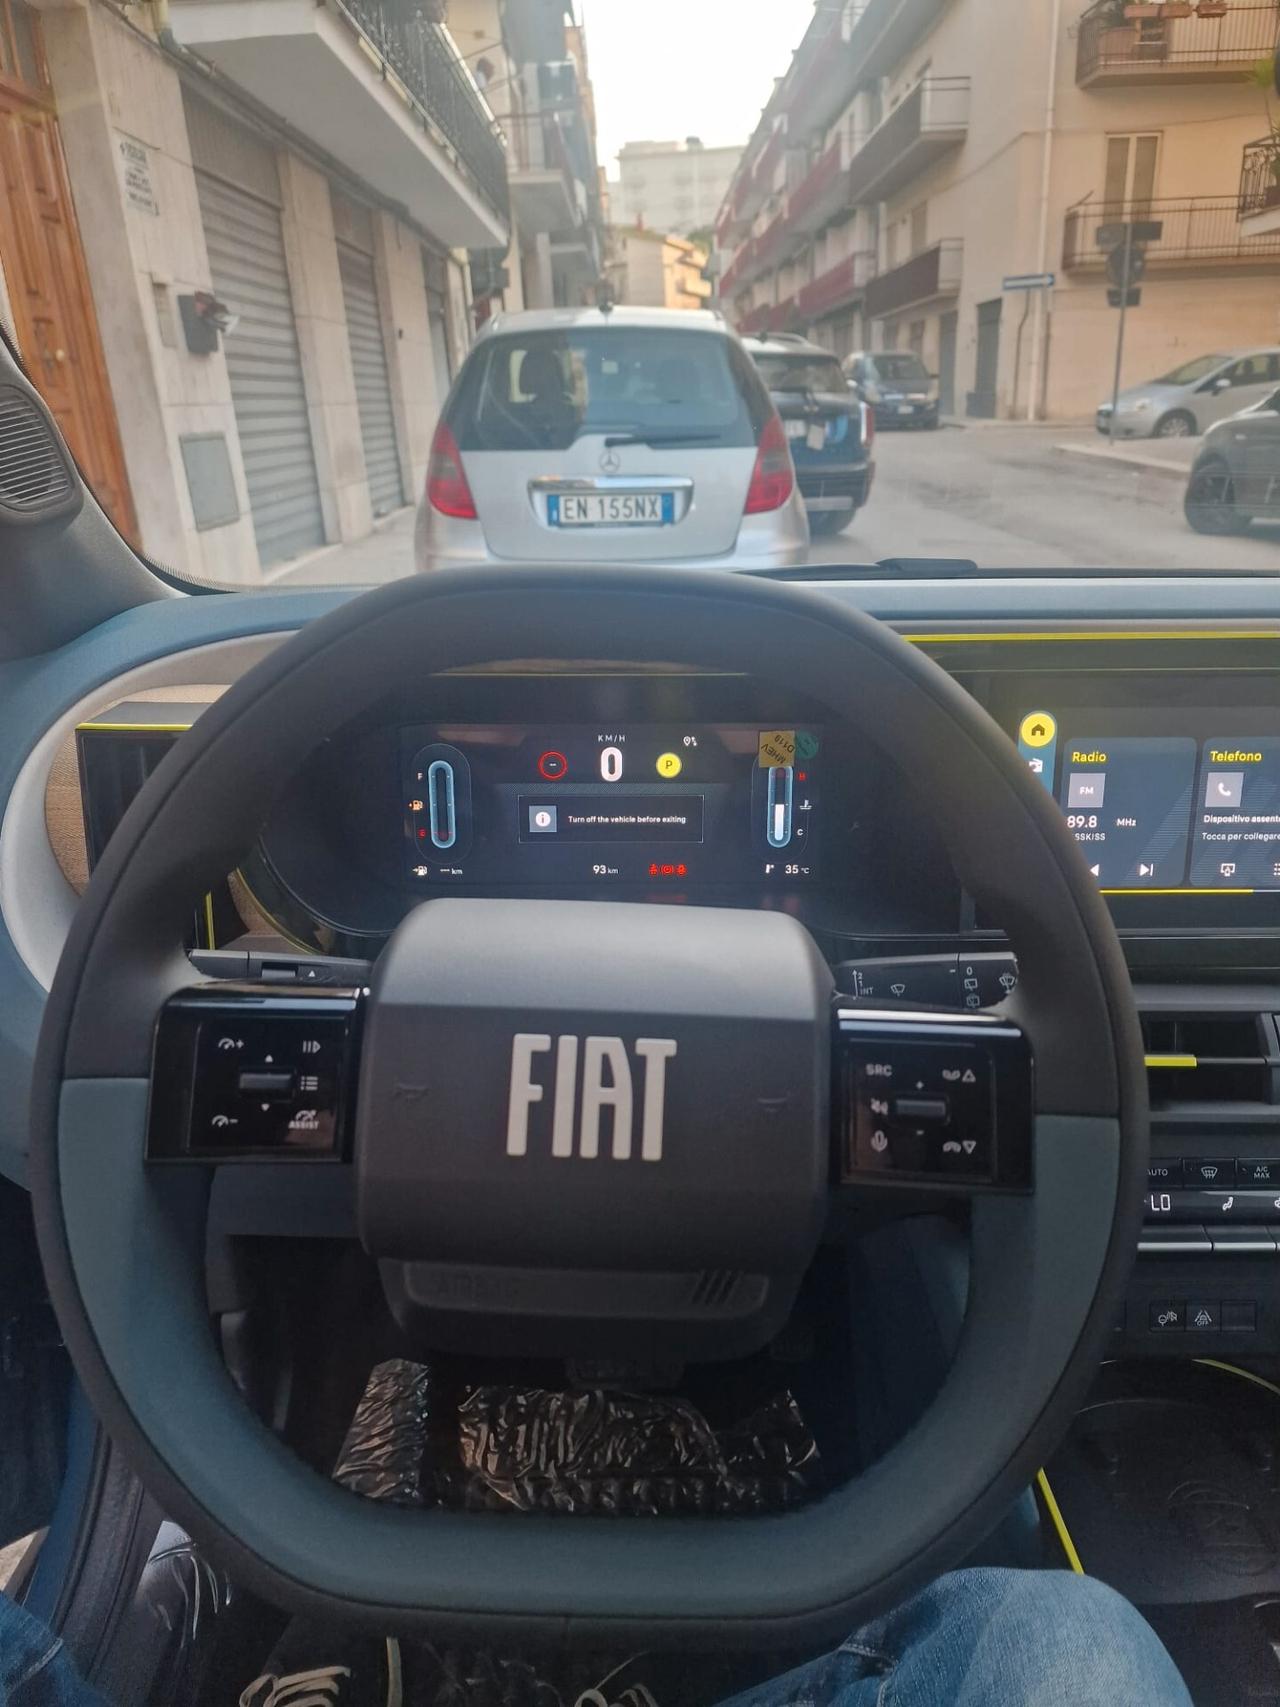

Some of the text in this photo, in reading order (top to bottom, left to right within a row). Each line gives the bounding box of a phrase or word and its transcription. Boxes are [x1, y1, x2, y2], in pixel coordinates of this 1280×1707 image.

[564, 497, 658, 519] EN 155NX
[597, 734, 626, 743] KM/H
[760, 743, 786, 764] MHEV
[1072, 751, 1107, 763] Radio
[1210, 750, 1262, 762] Telefono
[600, 746, 623, 782] 0
[665, 760, 673, 769] P
[417, 772, 423, 780] F
[1079, 787, 1094, 795] FM
[662, 816, 686, 825] exiting
[1066, 815, 1137, 829] 89.8 MHz
[1203, 814, 1250, 825] Dispositivo
[797, 828, 804, 836] C
[1202, 832, 1226, 841] Tocca
[1227, 834, 1242, 842] per
[451, 867, 463, 875] km
[593, 864, 619, 875] 93 km
[785, 864, 799, 874] 35
[966, 967, 973, 976] 0
[860, 987, 874, 996] INT
[866, 1063, 893, 1077] SRC
[506, 1033, 677, 1161] FIAT
[288, 1120, 319, 1130] ASSIST
[1150, 1193, 1171, 1212] LO
